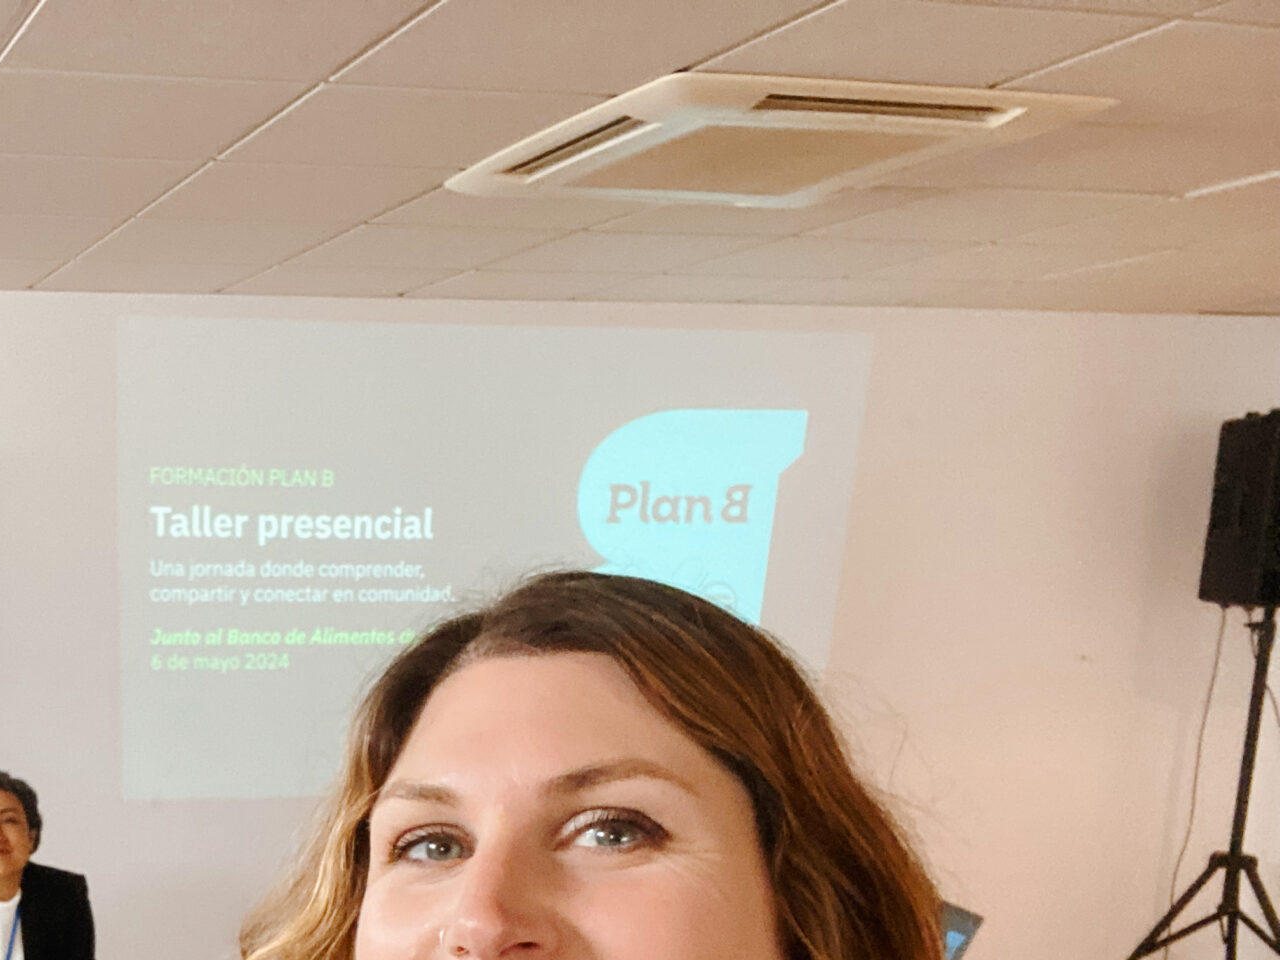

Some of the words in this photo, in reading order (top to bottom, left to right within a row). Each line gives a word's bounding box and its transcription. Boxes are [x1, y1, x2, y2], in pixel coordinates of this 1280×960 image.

[149, 463, 264, 486] FORMACIÓN
[268, 468, 317, 487] PLAN
[320, 469, 335, 488] B
[605, 480, 713, 525] Plan
[149, 504, 250, 538] Taller
[257, 505, 434, 547] presencial
[149, 560, 185, 578] Una
[189, 561, 256, 581] jornada
[259, 561, 315, 578] donde
[318, 561, 425, 582] comprender,
[149, 586, 234, 604] compartir
[239, 590, 250, 606] y
[253, 587, 329, 602] conectar
[332, 588, 355, 603] en
[357, 586, 456, 603] comunidad.
[150, 628, 201, 646] Junto
[205, 628, 223, 646] al
[227, 629, 281, 645] Banco
[285, 628, 307, 645] de
[310, 628, 395, 645] Alimentos
[150, 654, 162, 670] 6
[166, 653, 189, 670] de
[193, 656, 240, 673] mayo
[245, 653, 290, 670] 2024
